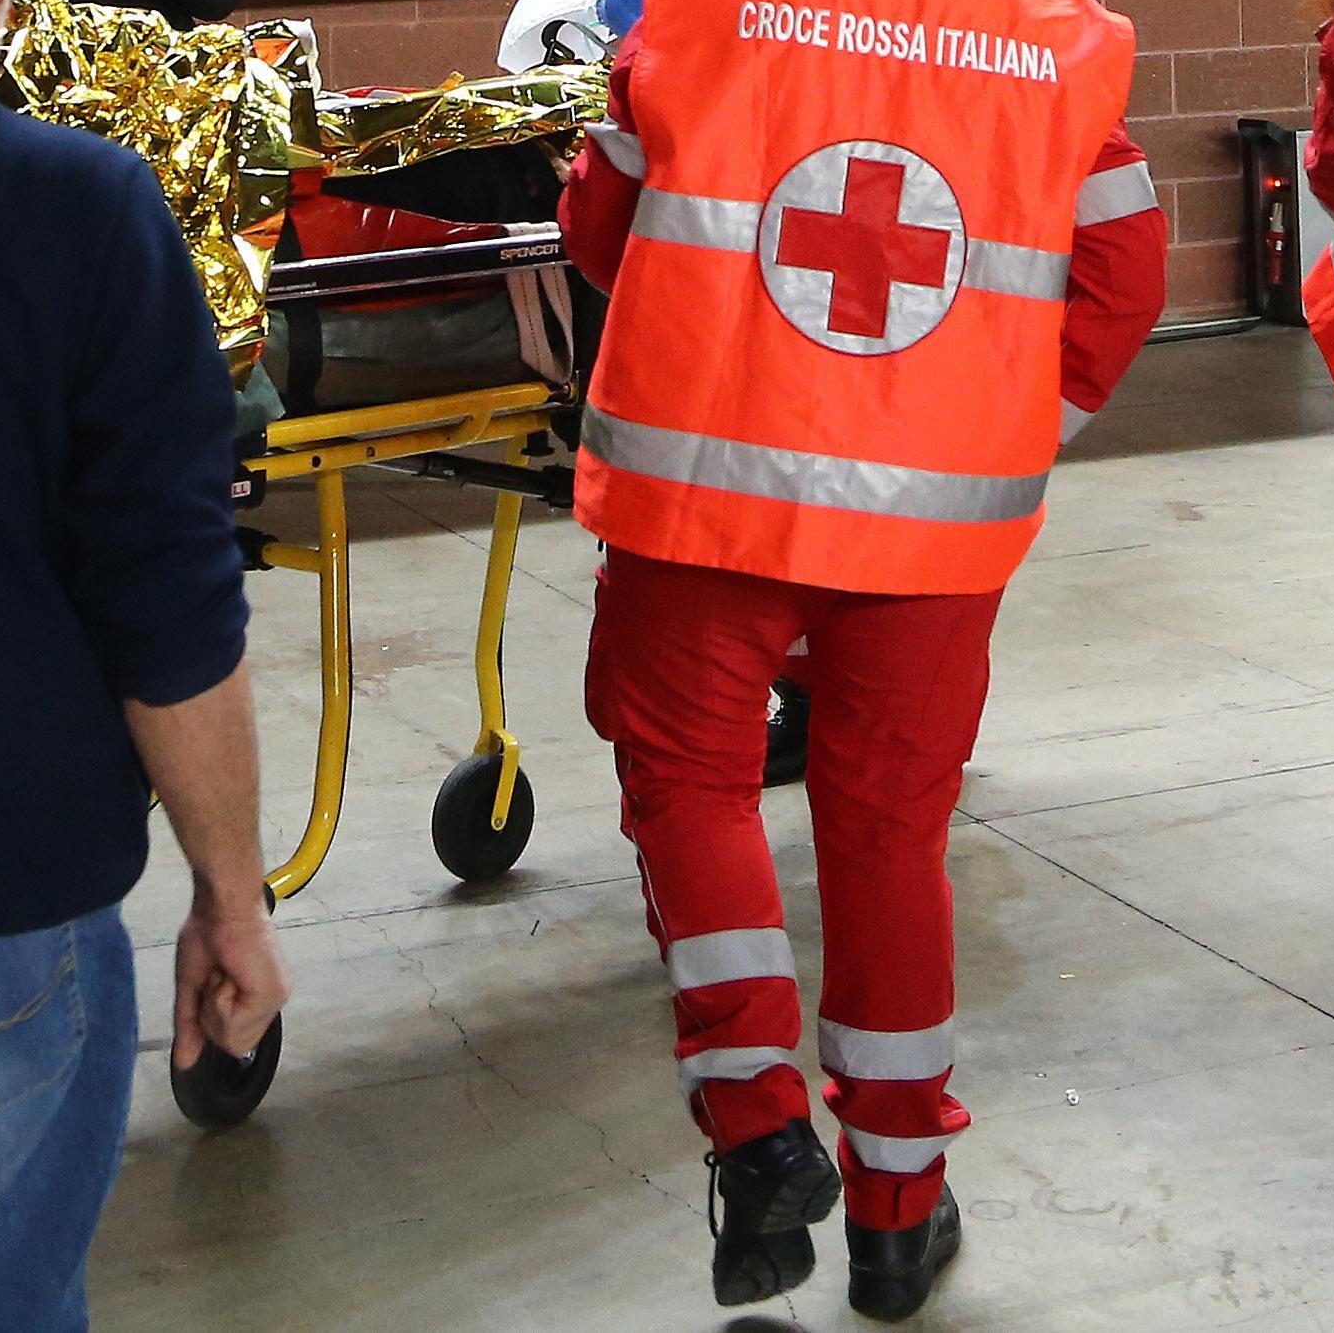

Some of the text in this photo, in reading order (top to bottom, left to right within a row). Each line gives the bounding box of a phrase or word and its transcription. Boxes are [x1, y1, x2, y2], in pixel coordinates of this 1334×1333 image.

[738, 0, 1058, 83] CROCE ROSSA ITALIANA
[500, 244, 559, 261] SPENCER
